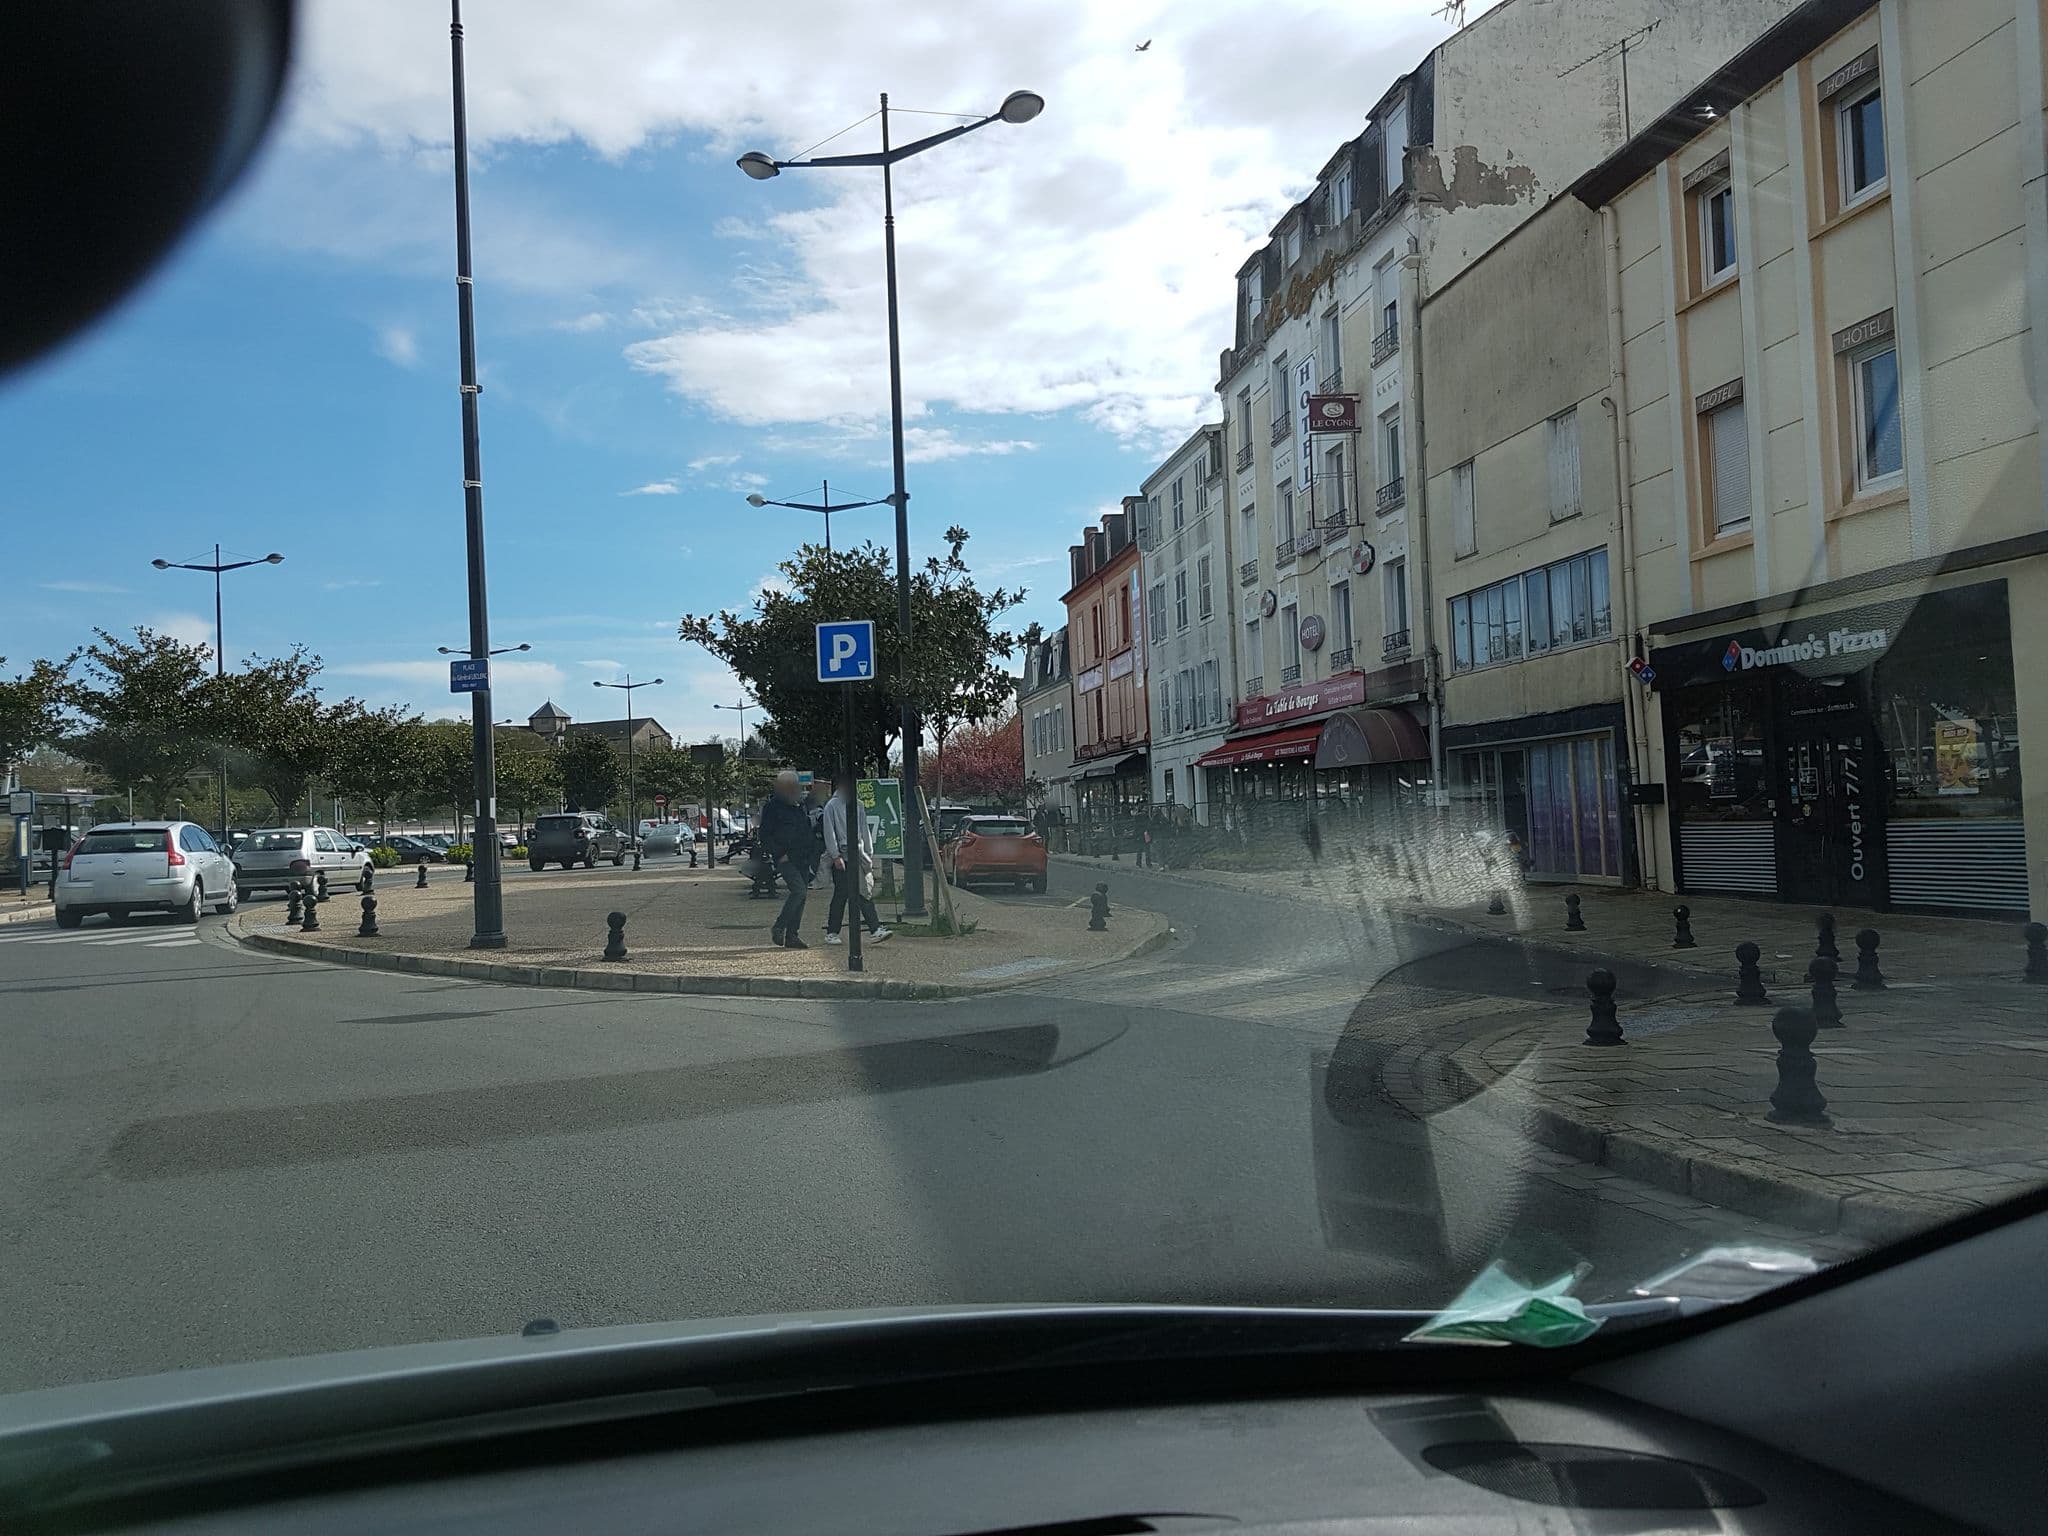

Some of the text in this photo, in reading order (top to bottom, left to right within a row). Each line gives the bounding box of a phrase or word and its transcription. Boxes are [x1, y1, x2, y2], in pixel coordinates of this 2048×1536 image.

[1826, 59, 1866, 94] HOTEL
[1687, 155, 1718, 189] HOTEL
[1841, 319, 1885, 348] HOTEL
[1701, 385, 1732, 411] HOTEL
[1312, 418, 1354, 428] LE CYGNE
[1302, 624, 1319, 640] HOTEL
[829, 633, 857, 671] P
[1741, 627, 1888, 670] Domino's Pizza
[1265, 703, 1273, 716] La
[1273, 697, 1288, 715] Table
[1288, 694, 1296, 711] de
[1296, 694, 1319, 711] Bourges
[1843, 756, 1864, 881] Ouvert 7/7
